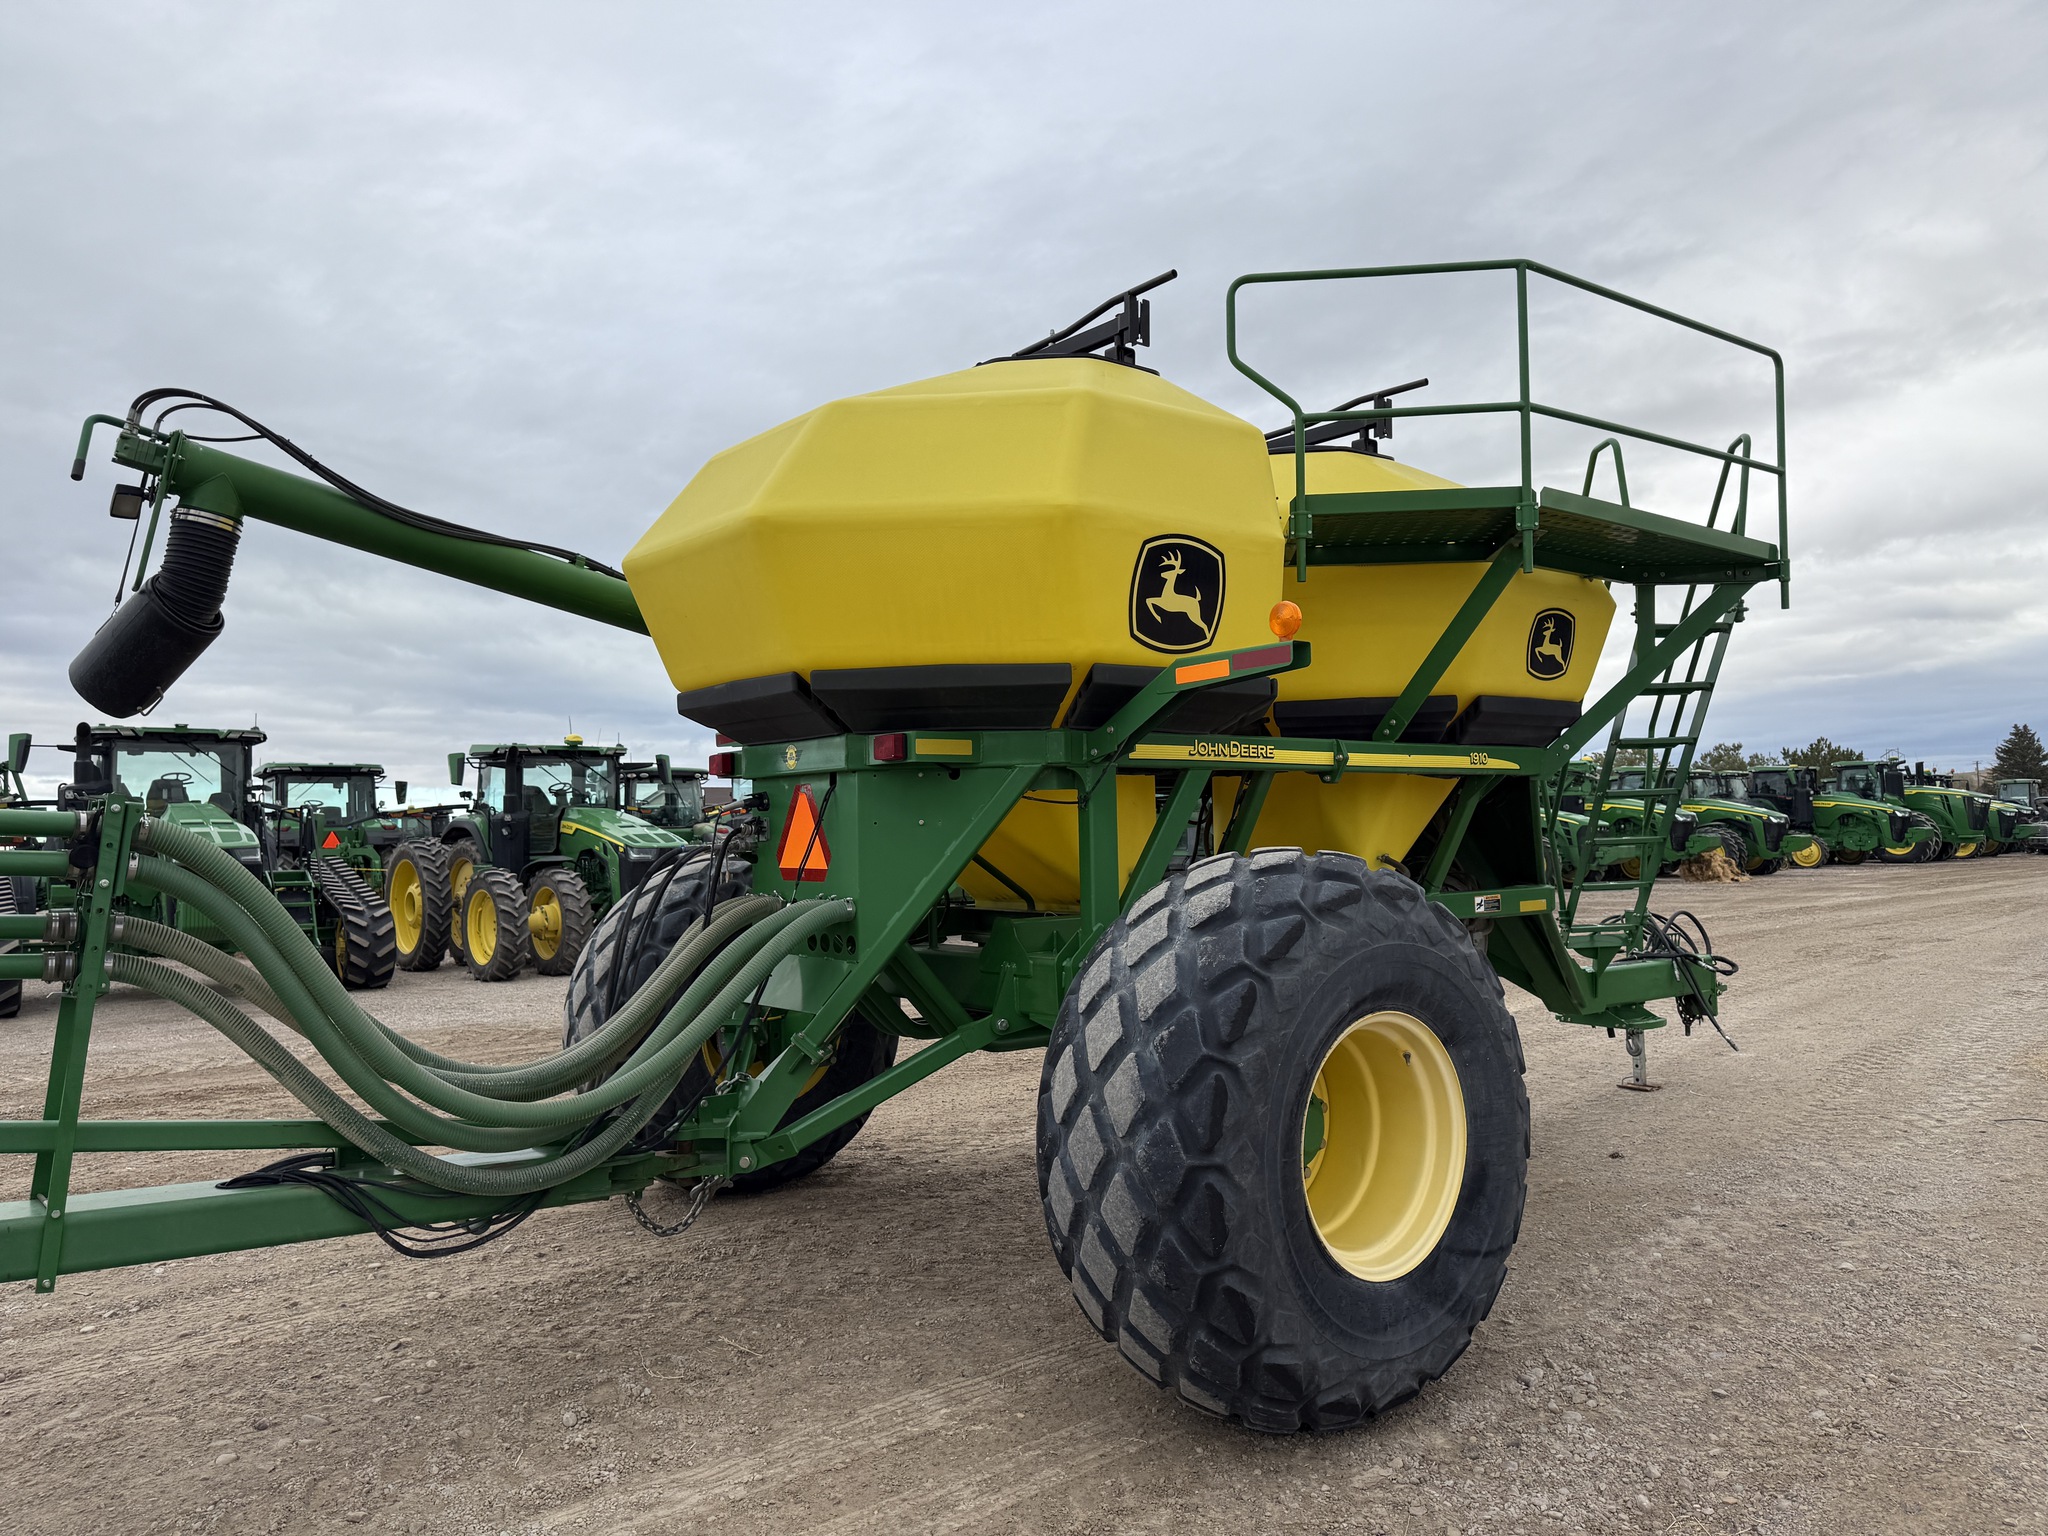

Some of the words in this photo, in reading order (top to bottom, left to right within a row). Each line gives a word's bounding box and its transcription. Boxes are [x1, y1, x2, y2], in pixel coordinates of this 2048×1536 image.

[1189, 739, 1228, 757] JOHN
[1229, 741, 1275, 759] DEERE
[1469, 752, 1489, 765] 1910
